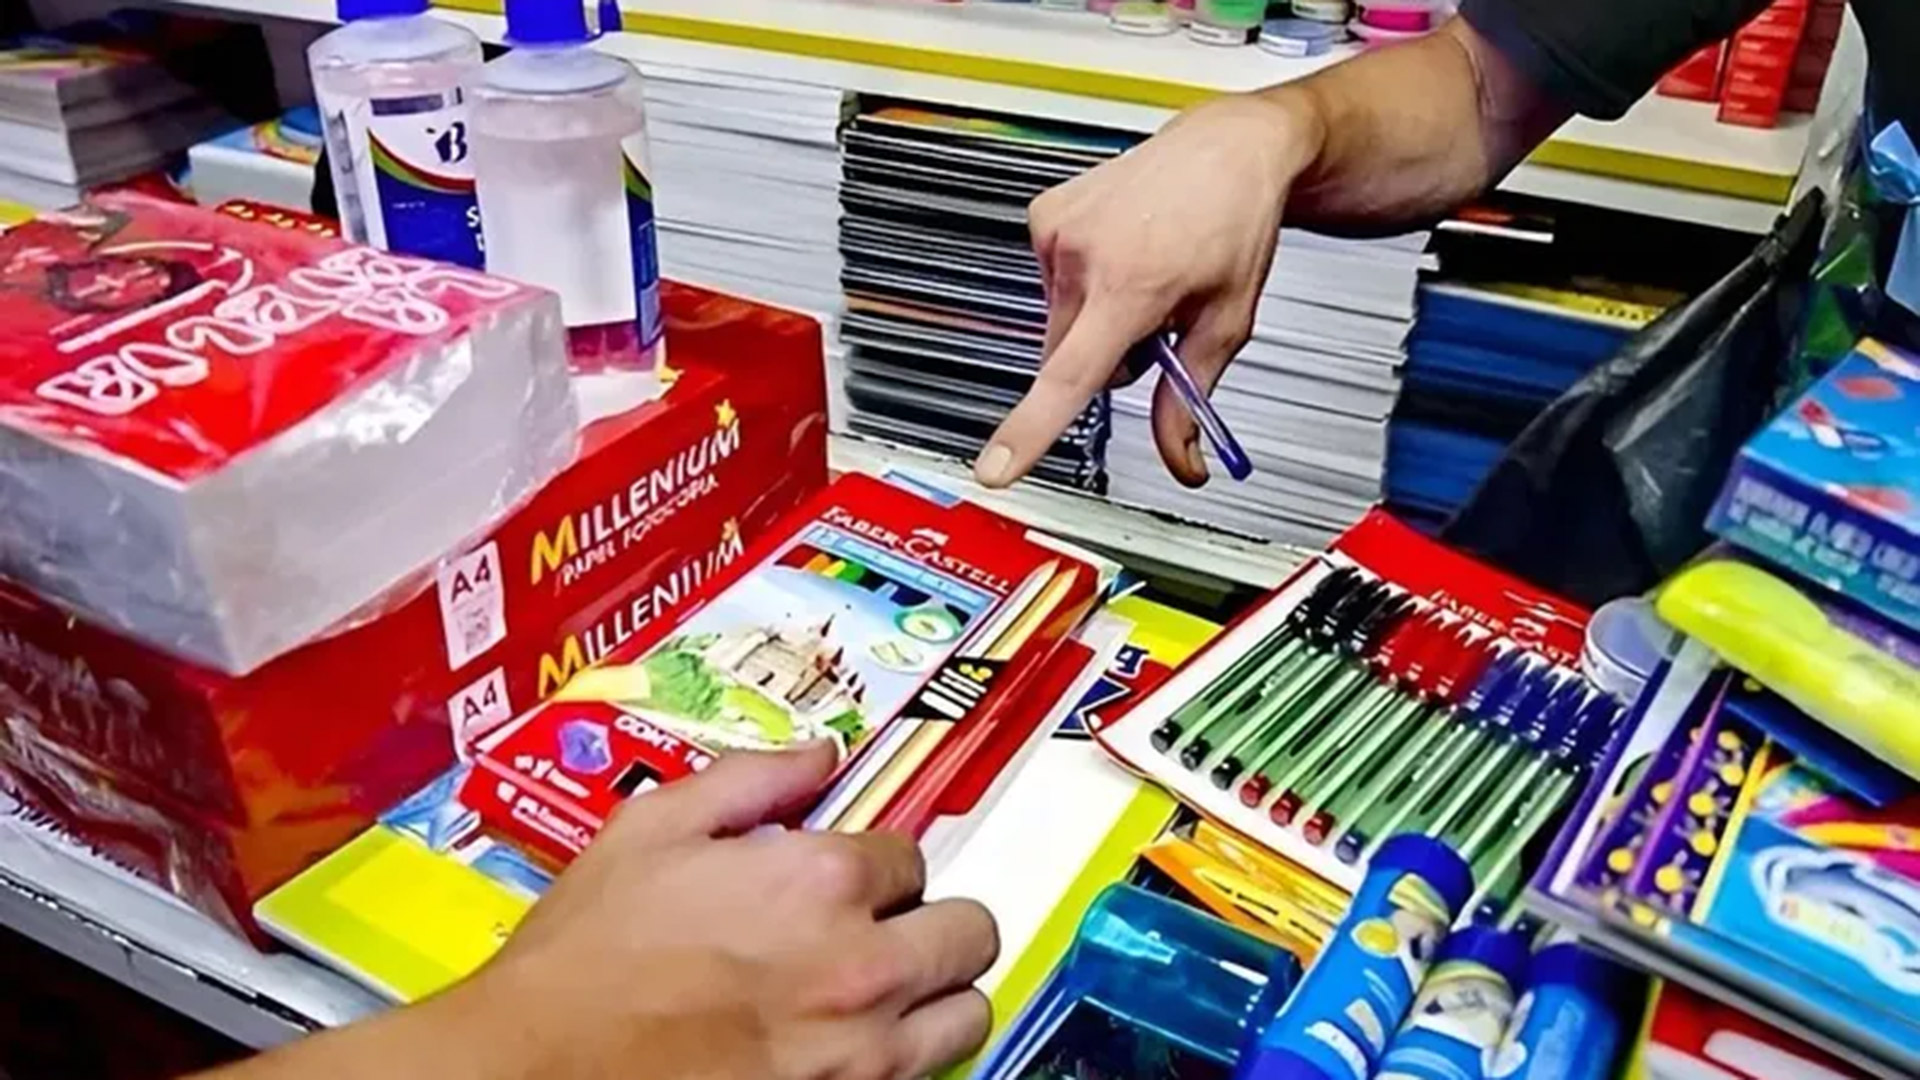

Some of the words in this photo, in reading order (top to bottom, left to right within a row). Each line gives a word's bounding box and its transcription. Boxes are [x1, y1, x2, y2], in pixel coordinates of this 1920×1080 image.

[530, 417, 741, 585] MILLENIUM
[451, 554, 492, 603] A4
[464, 680, 498, 726] A4
